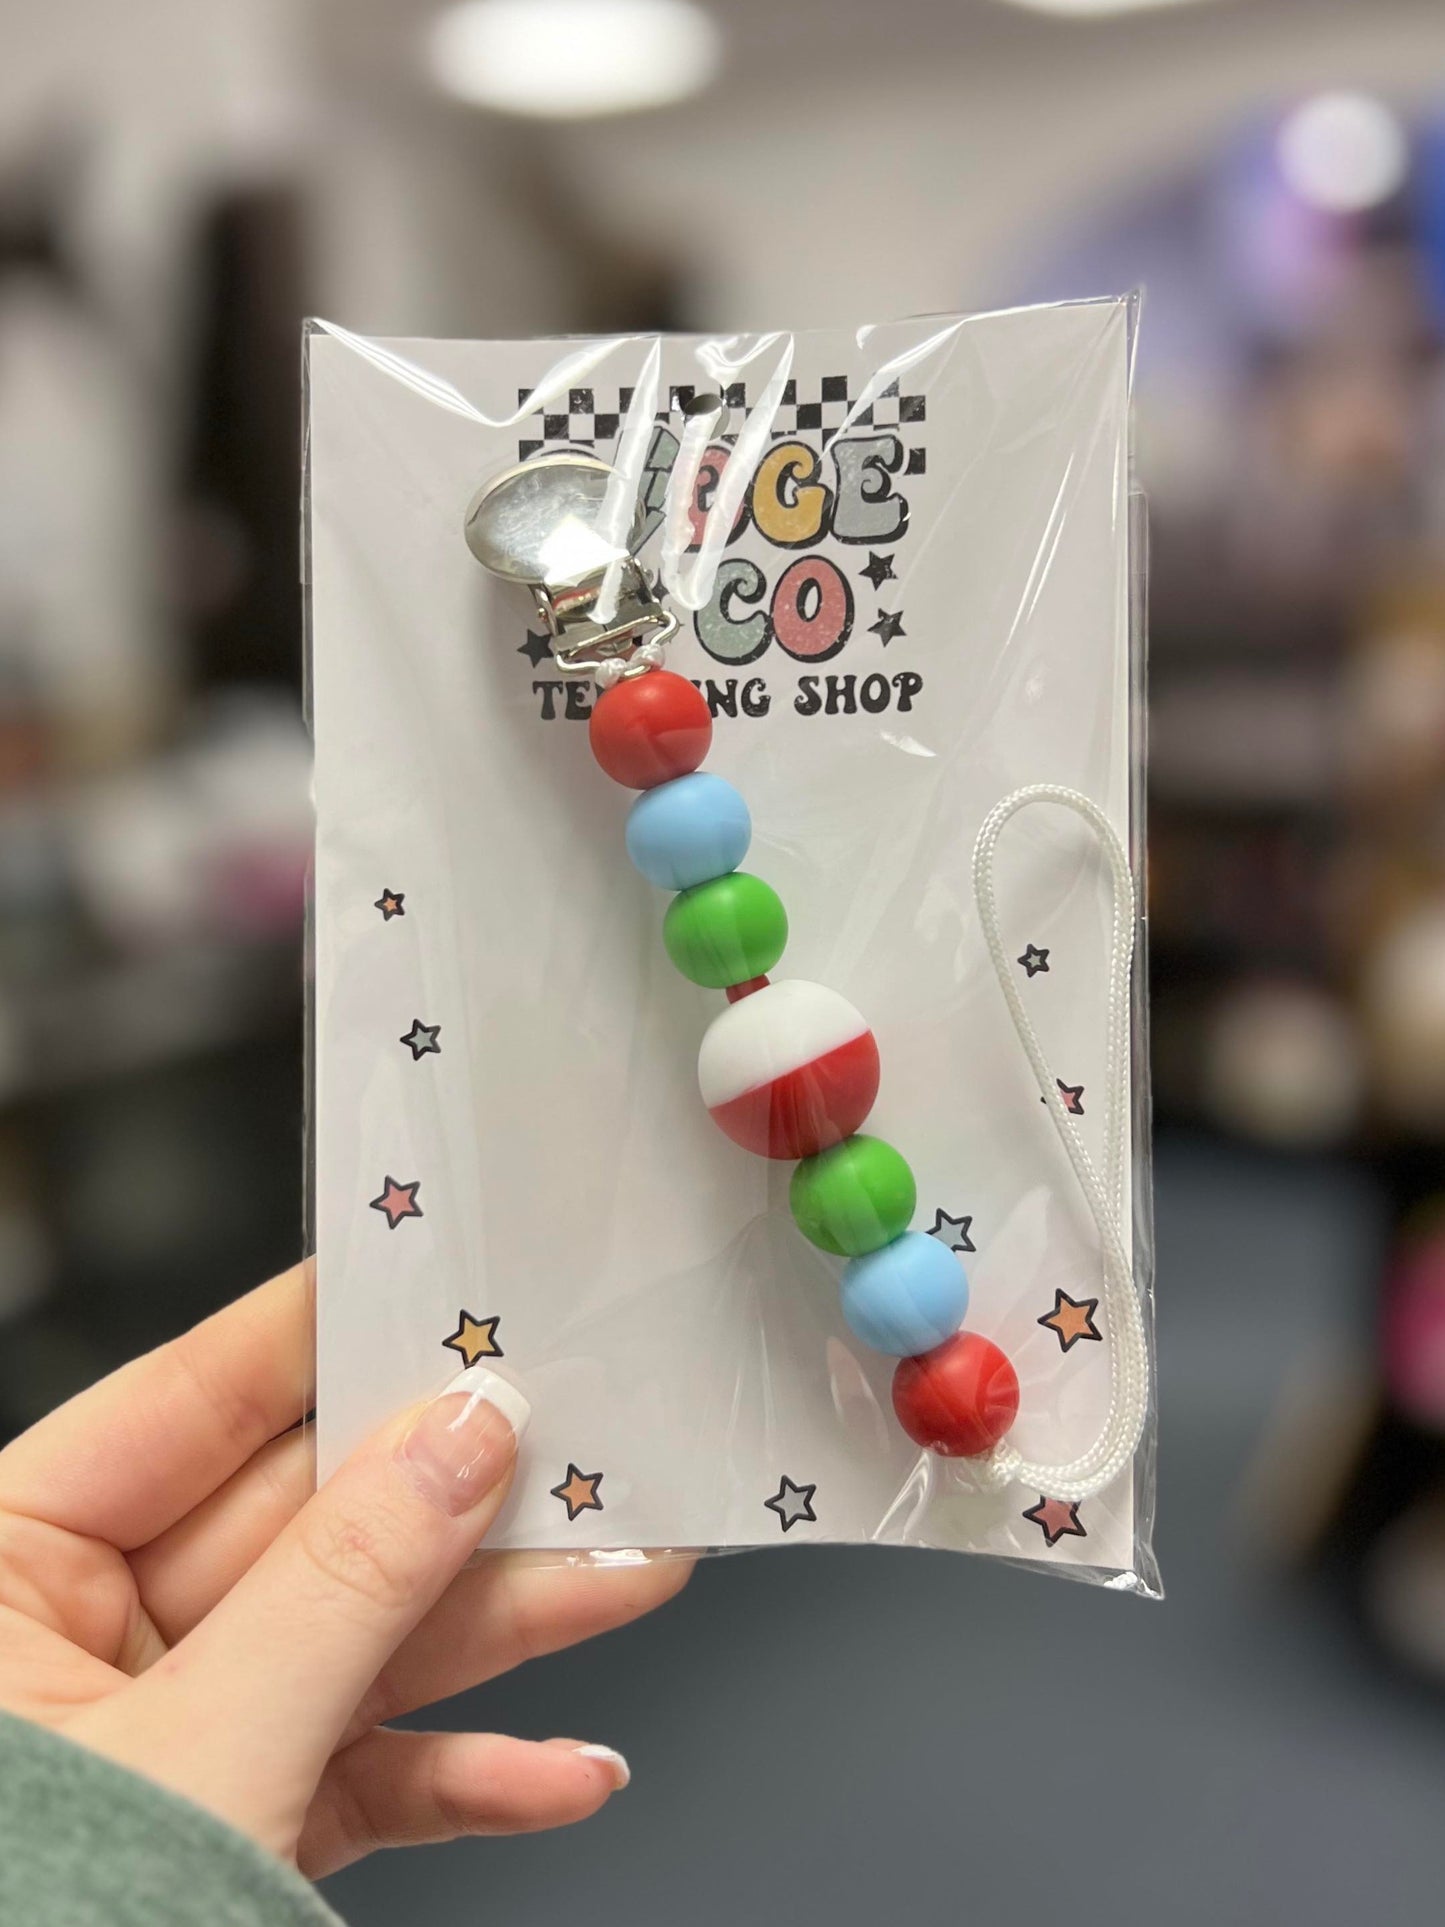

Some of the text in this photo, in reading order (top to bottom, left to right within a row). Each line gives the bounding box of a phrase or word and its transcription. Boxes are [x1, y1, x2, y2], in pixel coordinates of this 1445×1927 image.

[694, 555, 855, 666] CO
[533, 672, 923, 720] TENG SHOP
